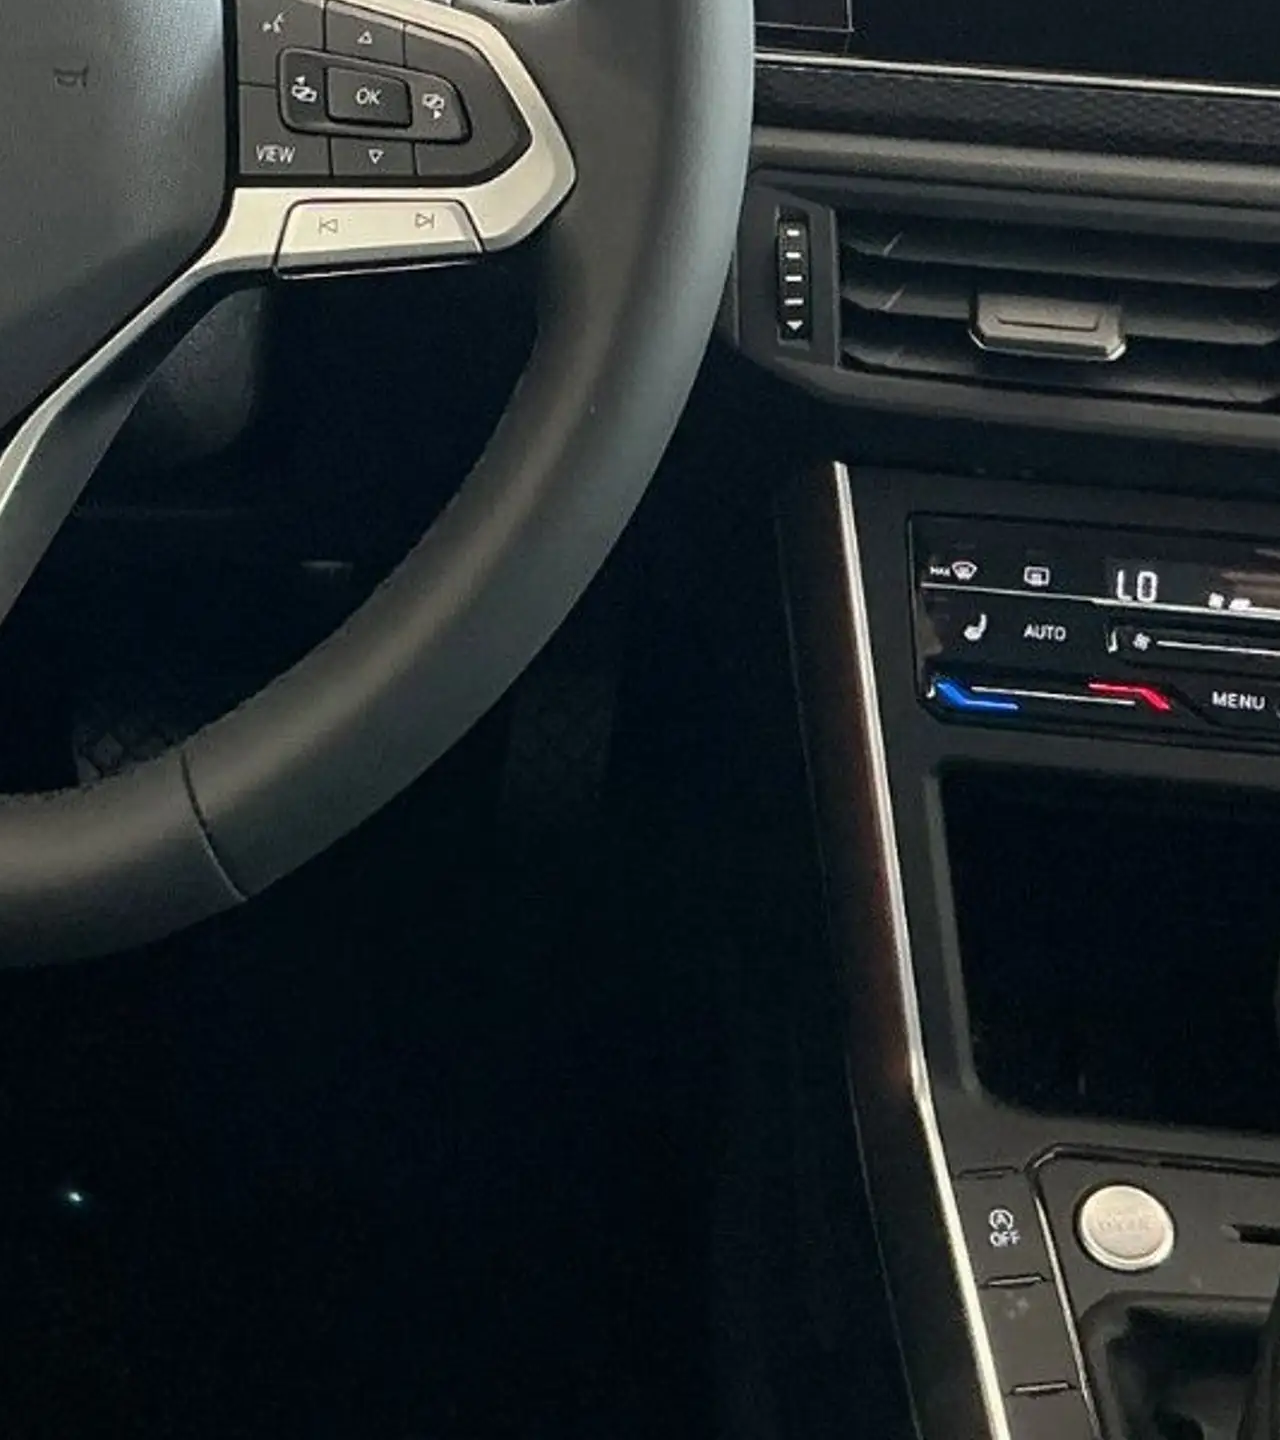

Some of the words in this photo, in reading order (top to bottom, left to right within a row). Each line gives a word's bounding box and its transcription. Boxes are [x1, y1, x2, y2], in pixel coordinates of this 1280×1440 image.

[355, 87, 382, 105] OK
[255, 146, 296, 164] VIEW
[1115, 570, 1158, 603] LO
[1024, 624, 1067, 641] AUTO
[1212, 691, 1266, 712] MENU
[989, 1231, 1020, 1248] OFF
